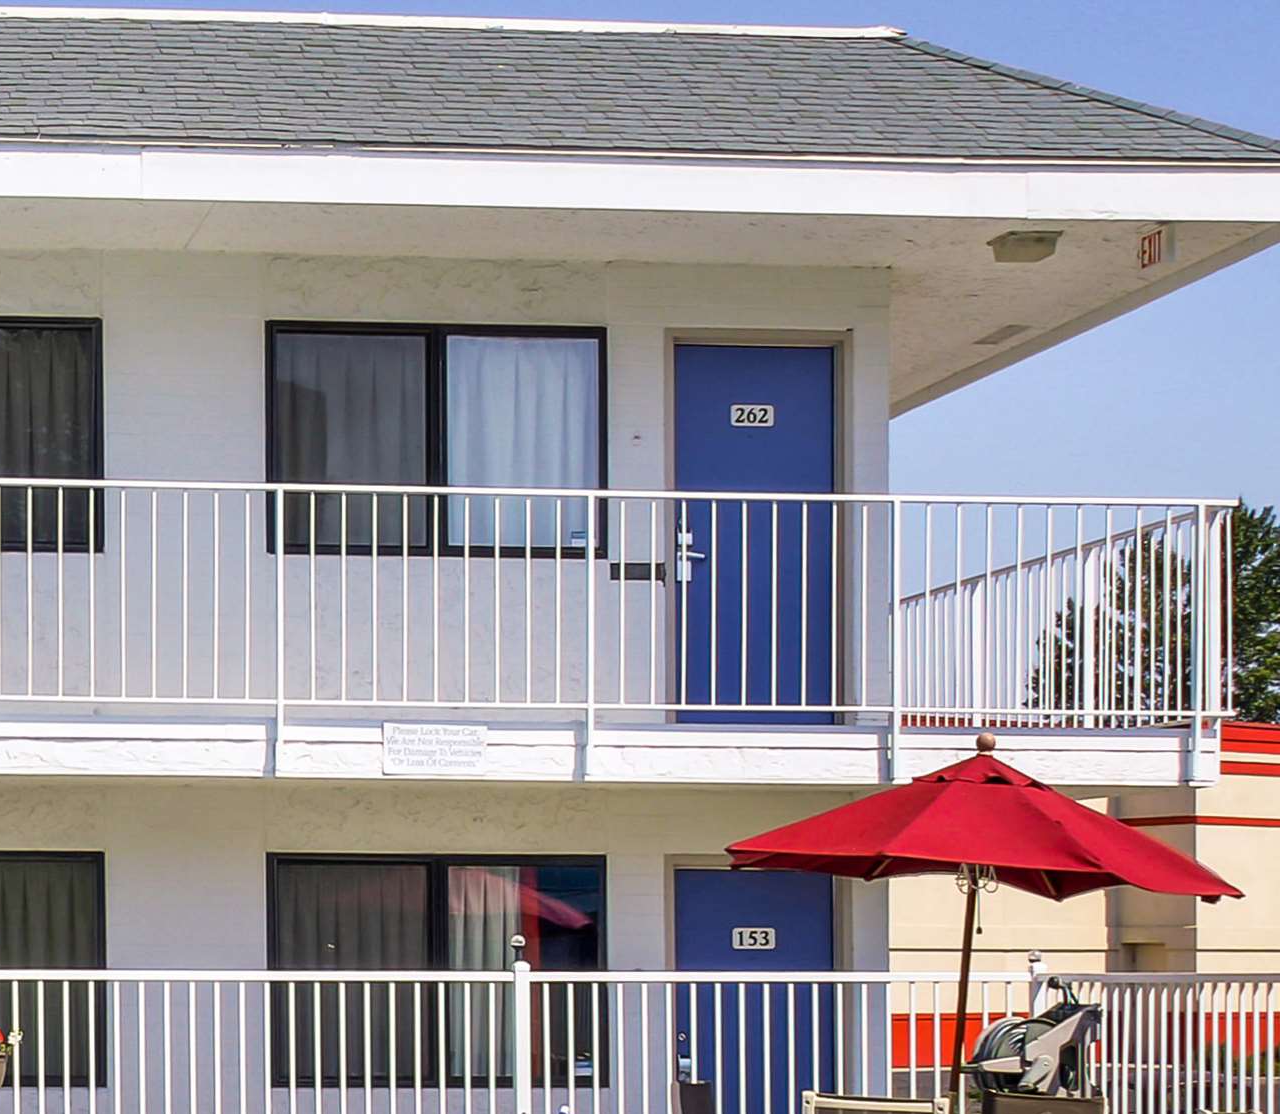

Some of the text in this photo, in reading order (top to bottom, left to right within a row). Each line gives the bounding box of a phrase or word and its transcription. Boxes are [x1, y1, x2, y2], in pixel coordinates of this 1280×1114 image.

[1141, 230, 1163, 269] EXIT
[734, 407, 769, 425] 262
[737, 930, 770, 948] 153
